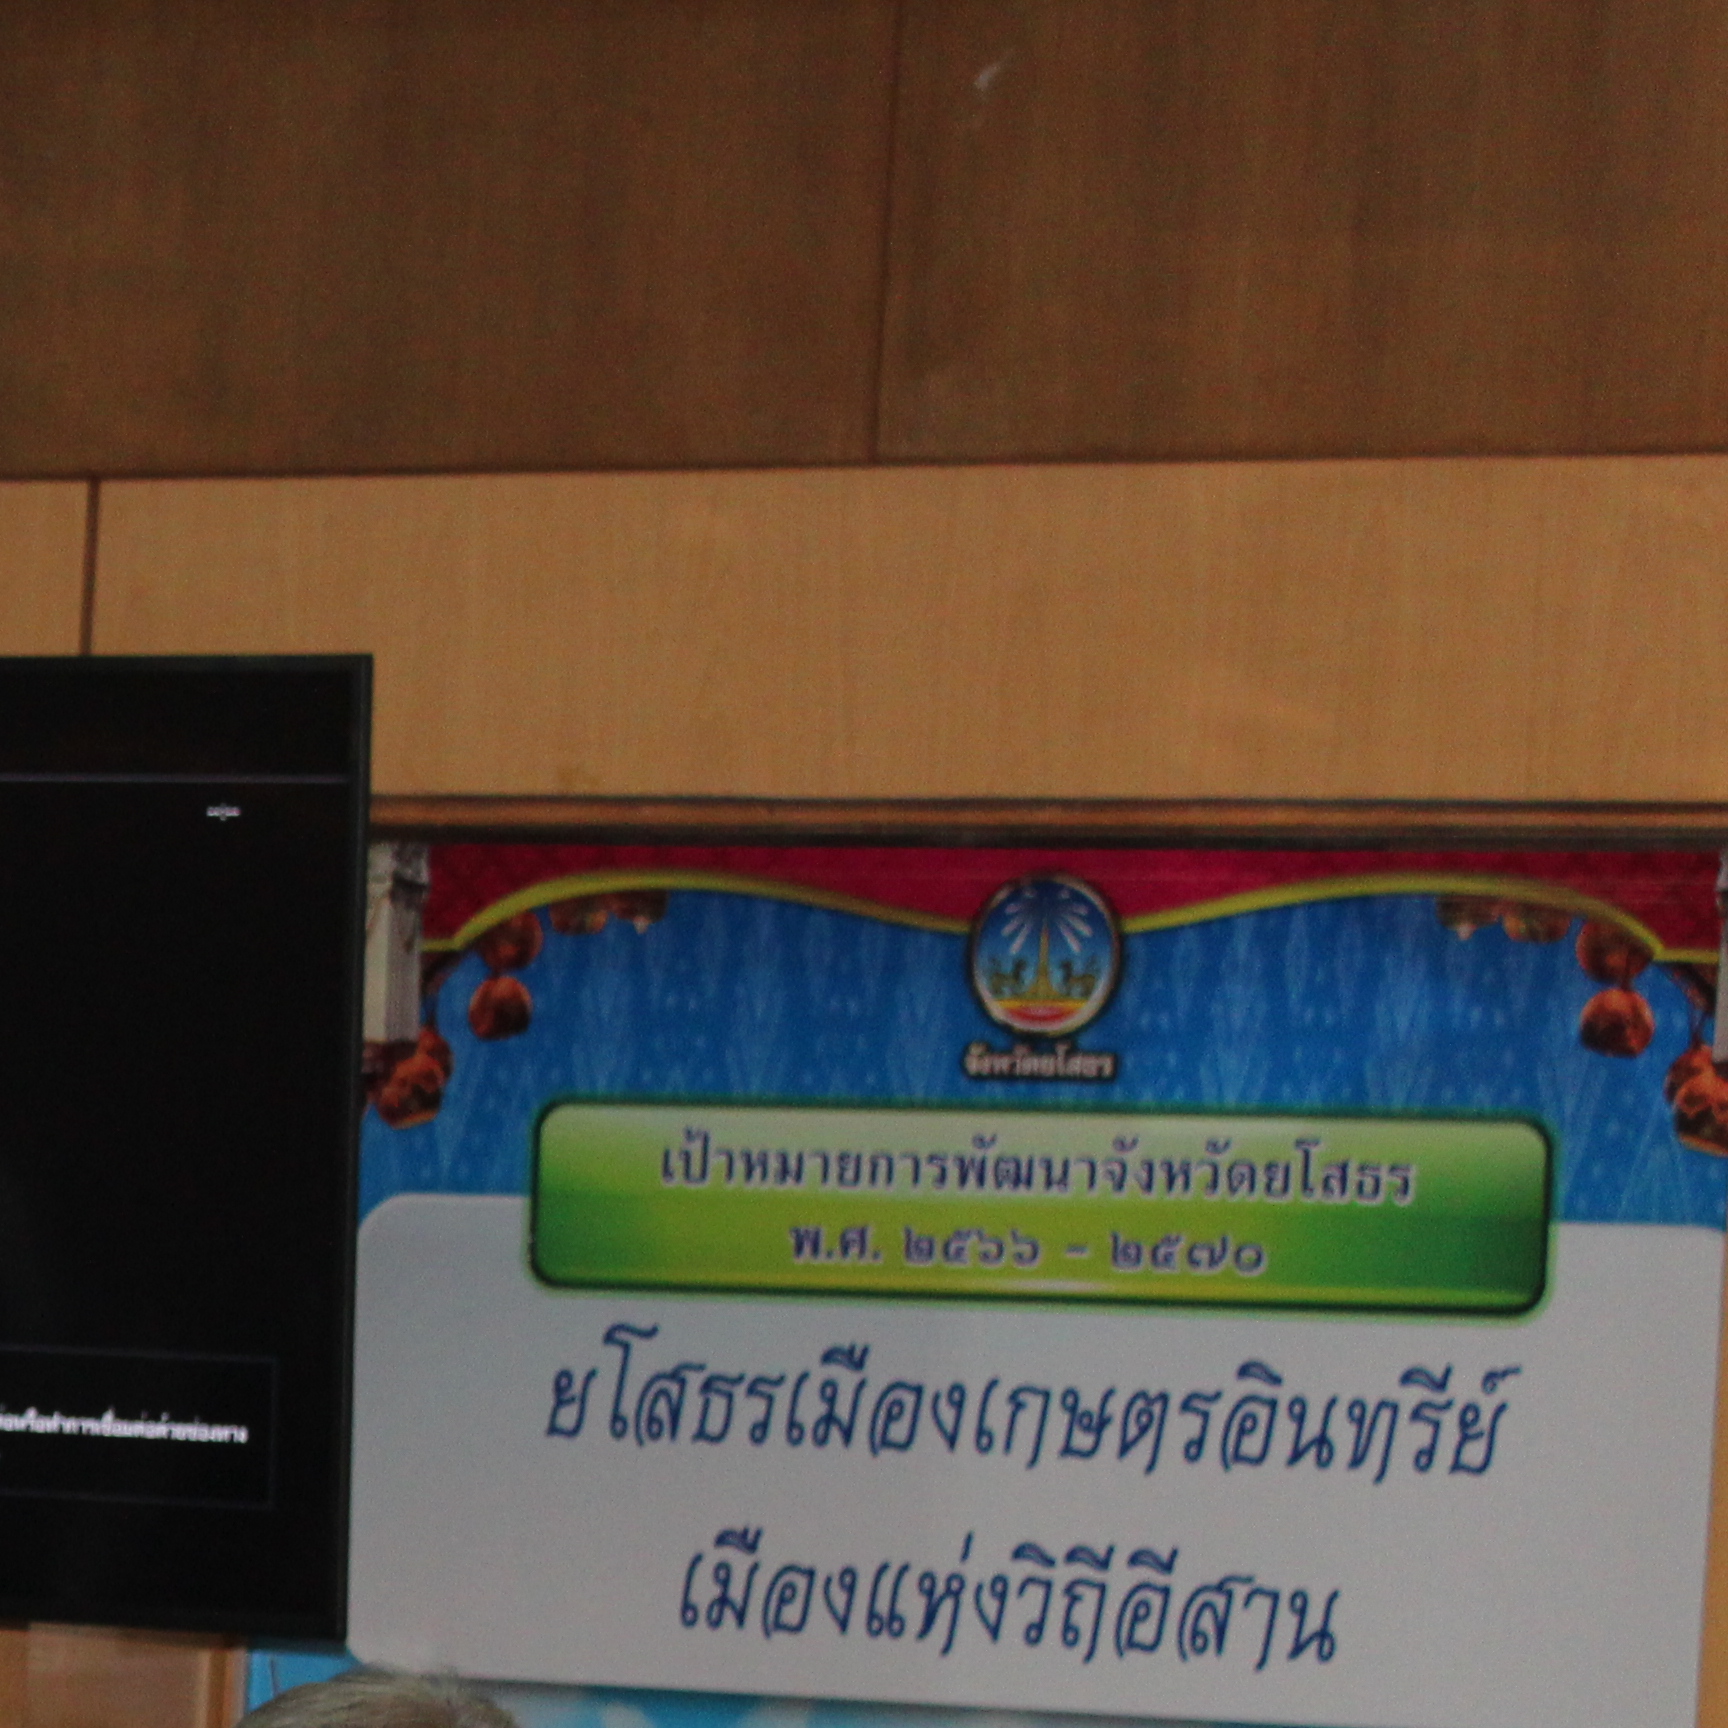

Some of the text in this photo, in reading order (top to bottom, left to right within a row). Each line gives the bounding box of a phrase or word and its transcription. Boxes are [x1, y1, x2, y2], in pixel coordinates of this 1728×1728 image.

[660, 1128, 1417, 1206] เป้าหมายการพัฒนาจังหวัดยโสธร
[789, 1221, 882, 1264] พ.ศ.
[1109, 1228, 1268, 1275] ๒๕๗๐
[544, 1322, 1522, 1485] ยโสธรเมืองเกษตรอินทรีย์
[678, 1527, 1339, 1672] เมืองแห่งวิถีอีสาน
